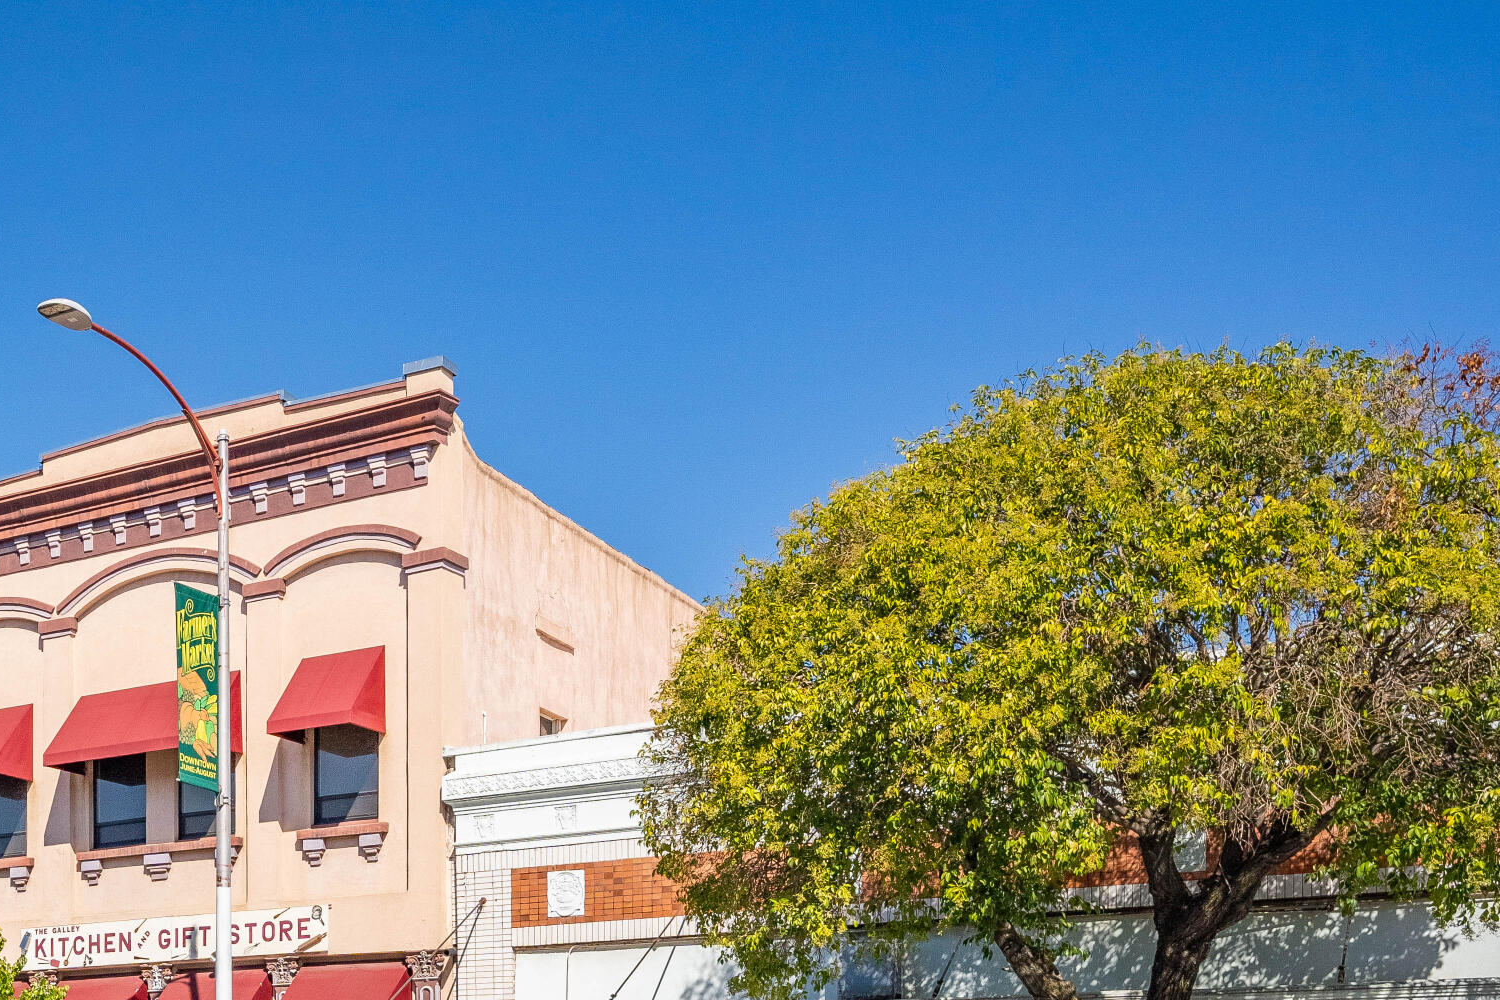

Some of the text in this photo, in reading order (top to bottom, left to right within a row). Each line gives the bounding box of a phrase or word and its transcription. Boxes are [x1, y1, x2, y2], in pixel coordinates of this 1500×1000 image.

[176, 608, 217, 649] Farmer's
[181, 637, 216, 676] Market
[180, 752, 217, 771] DOWNTOWN
[180, 762, 217, 779] JUNE-AUGUST
[34, 926, 80, 936] THE GALLEY
[34, 932, 132, 959] KITCHEN
[137, 929, 151, 950] AND
[231, 917, 311, 946] STORE
